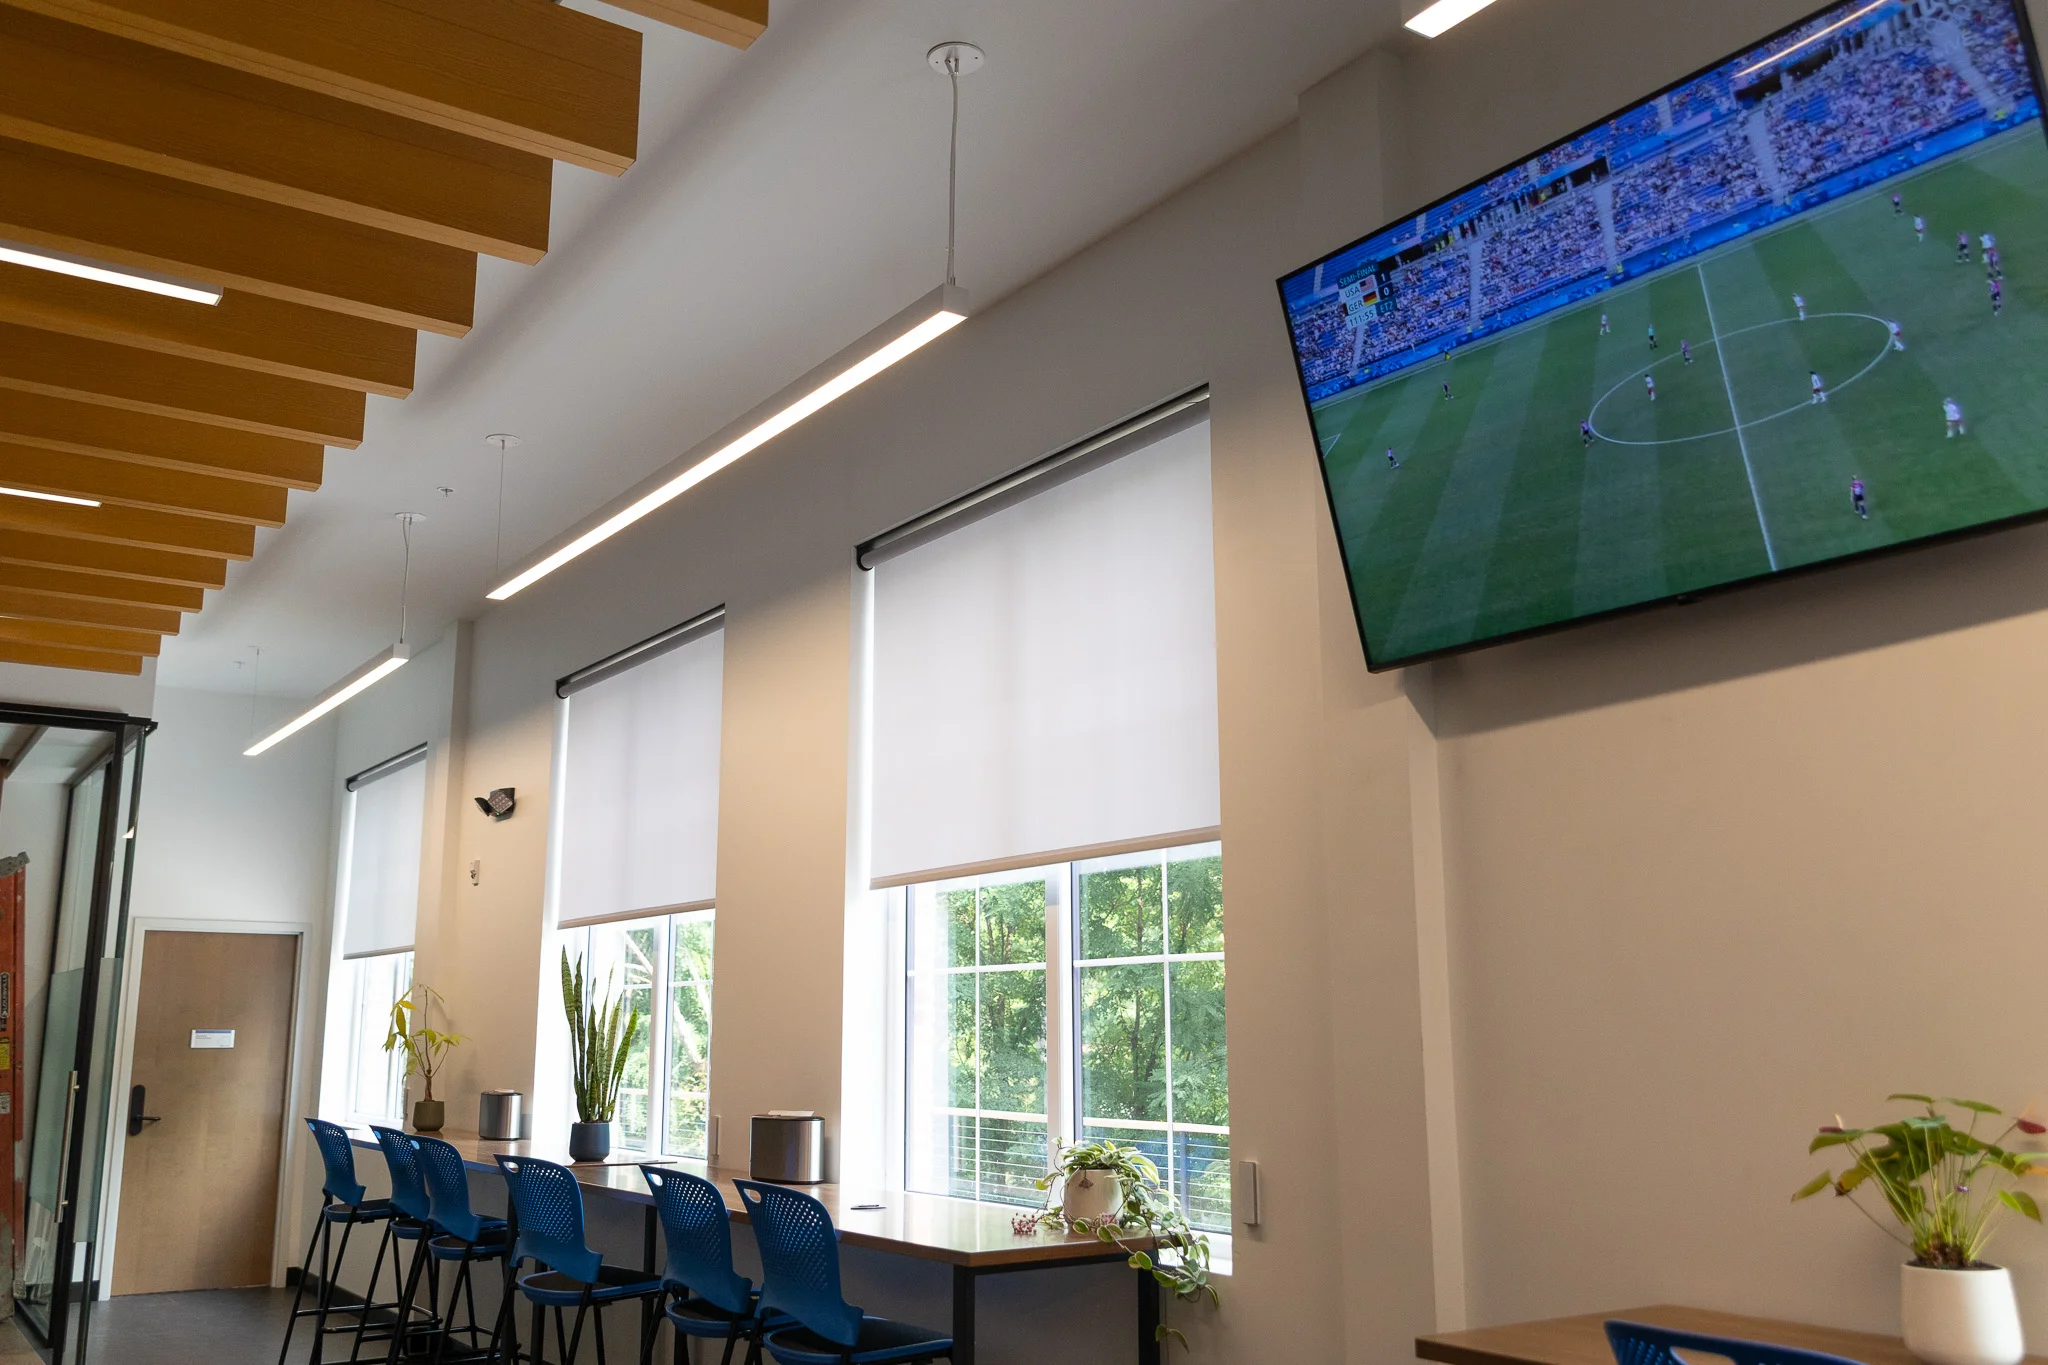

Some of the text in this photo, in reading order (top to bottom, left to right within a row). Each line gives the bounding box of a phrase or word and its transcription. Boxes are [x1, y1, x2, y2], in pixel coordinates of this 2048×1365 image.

[1339, 265, 1376, 287] SEMI-FINAL
[1344, 273, 1386, 298] USA 1
[1348, 287, 1390, 312] GER 0
[1350, 301, 1394, 326] 111:55 ET2
